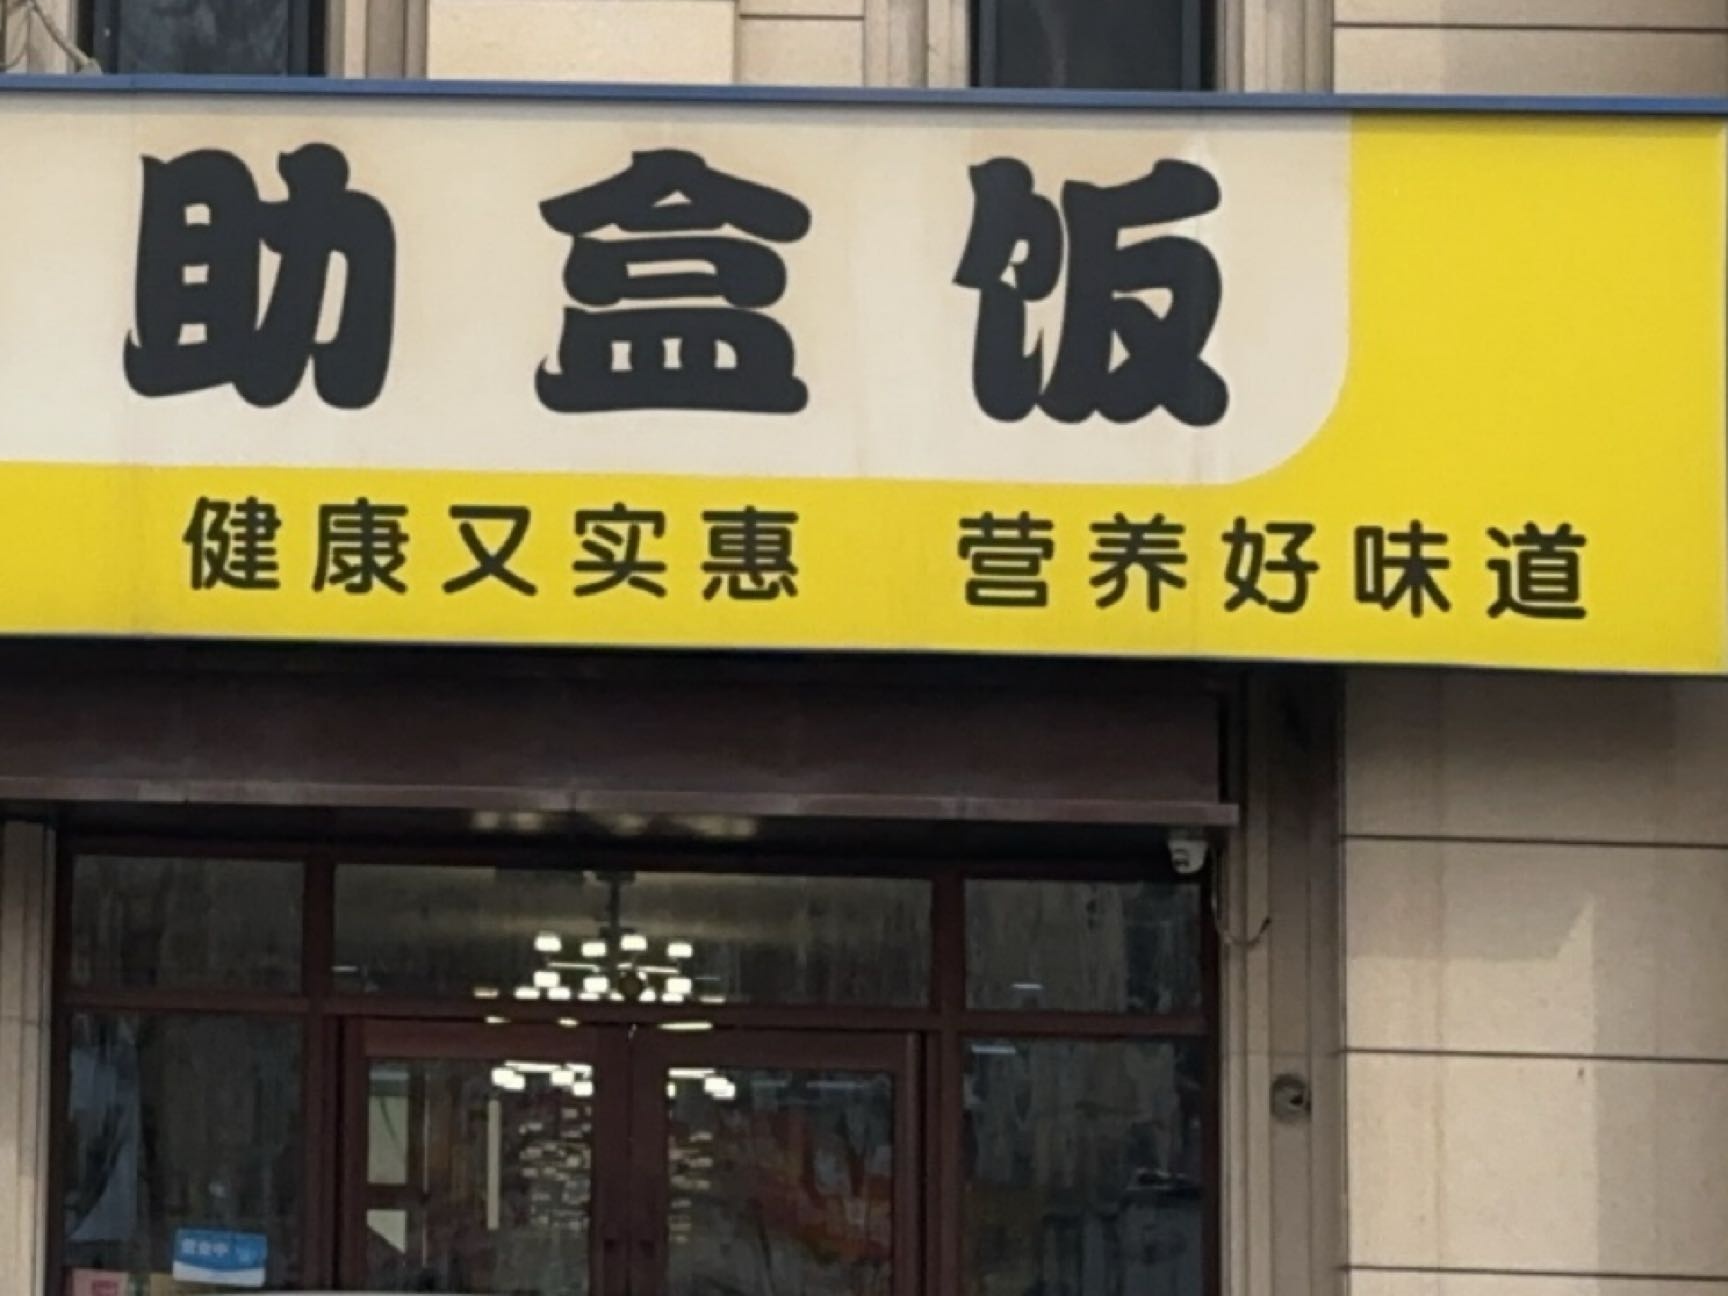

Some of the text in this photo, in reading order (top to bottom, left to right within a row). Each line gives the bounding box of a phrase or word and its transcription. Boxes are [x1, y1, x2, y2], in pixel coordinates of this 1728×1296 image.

[183, 496, 1587, 620] 健康又实惠 营养好味道
